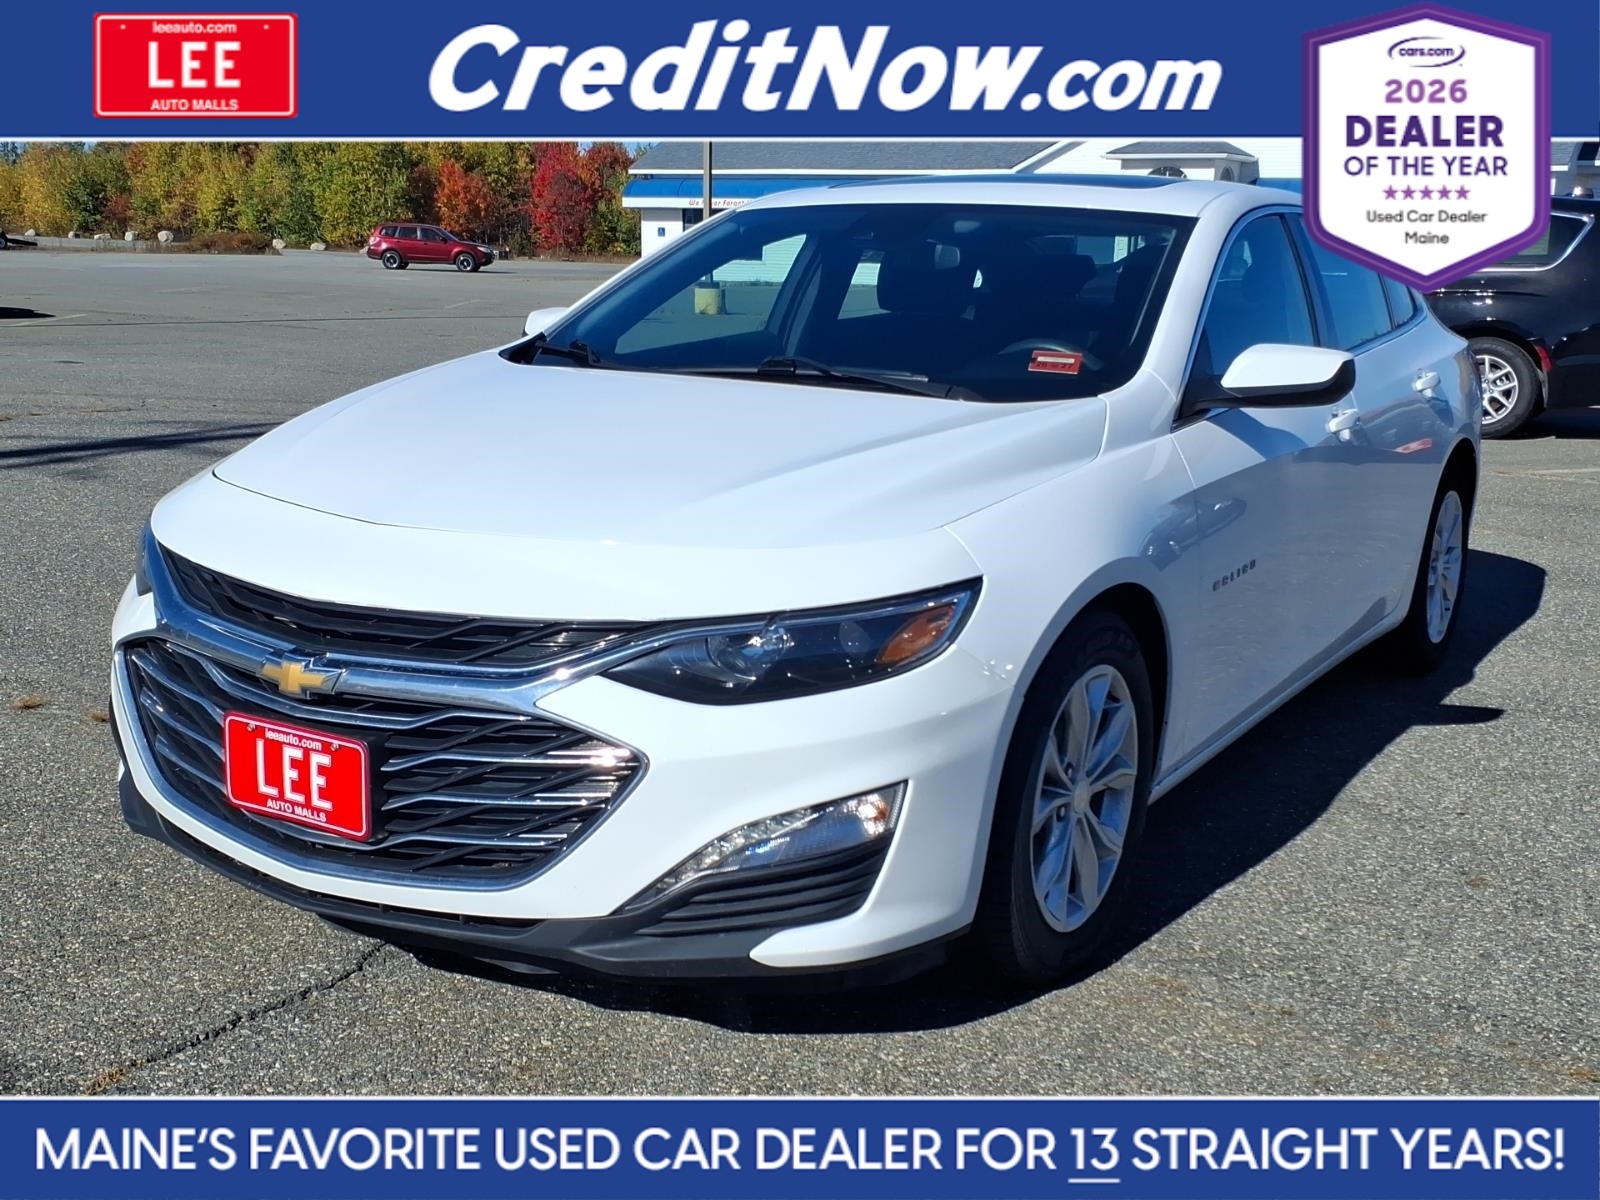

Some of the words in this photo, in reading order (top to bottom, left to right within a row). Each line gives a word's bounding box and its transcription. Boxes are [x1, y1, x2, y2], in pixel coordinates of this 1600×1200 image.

[265, 727, 322, 751] leeauto.com
[256, 738, 334, 812] LEE
[266, 798, 293, 813] AUTO
[294, 806, 327, 823] MALLS
